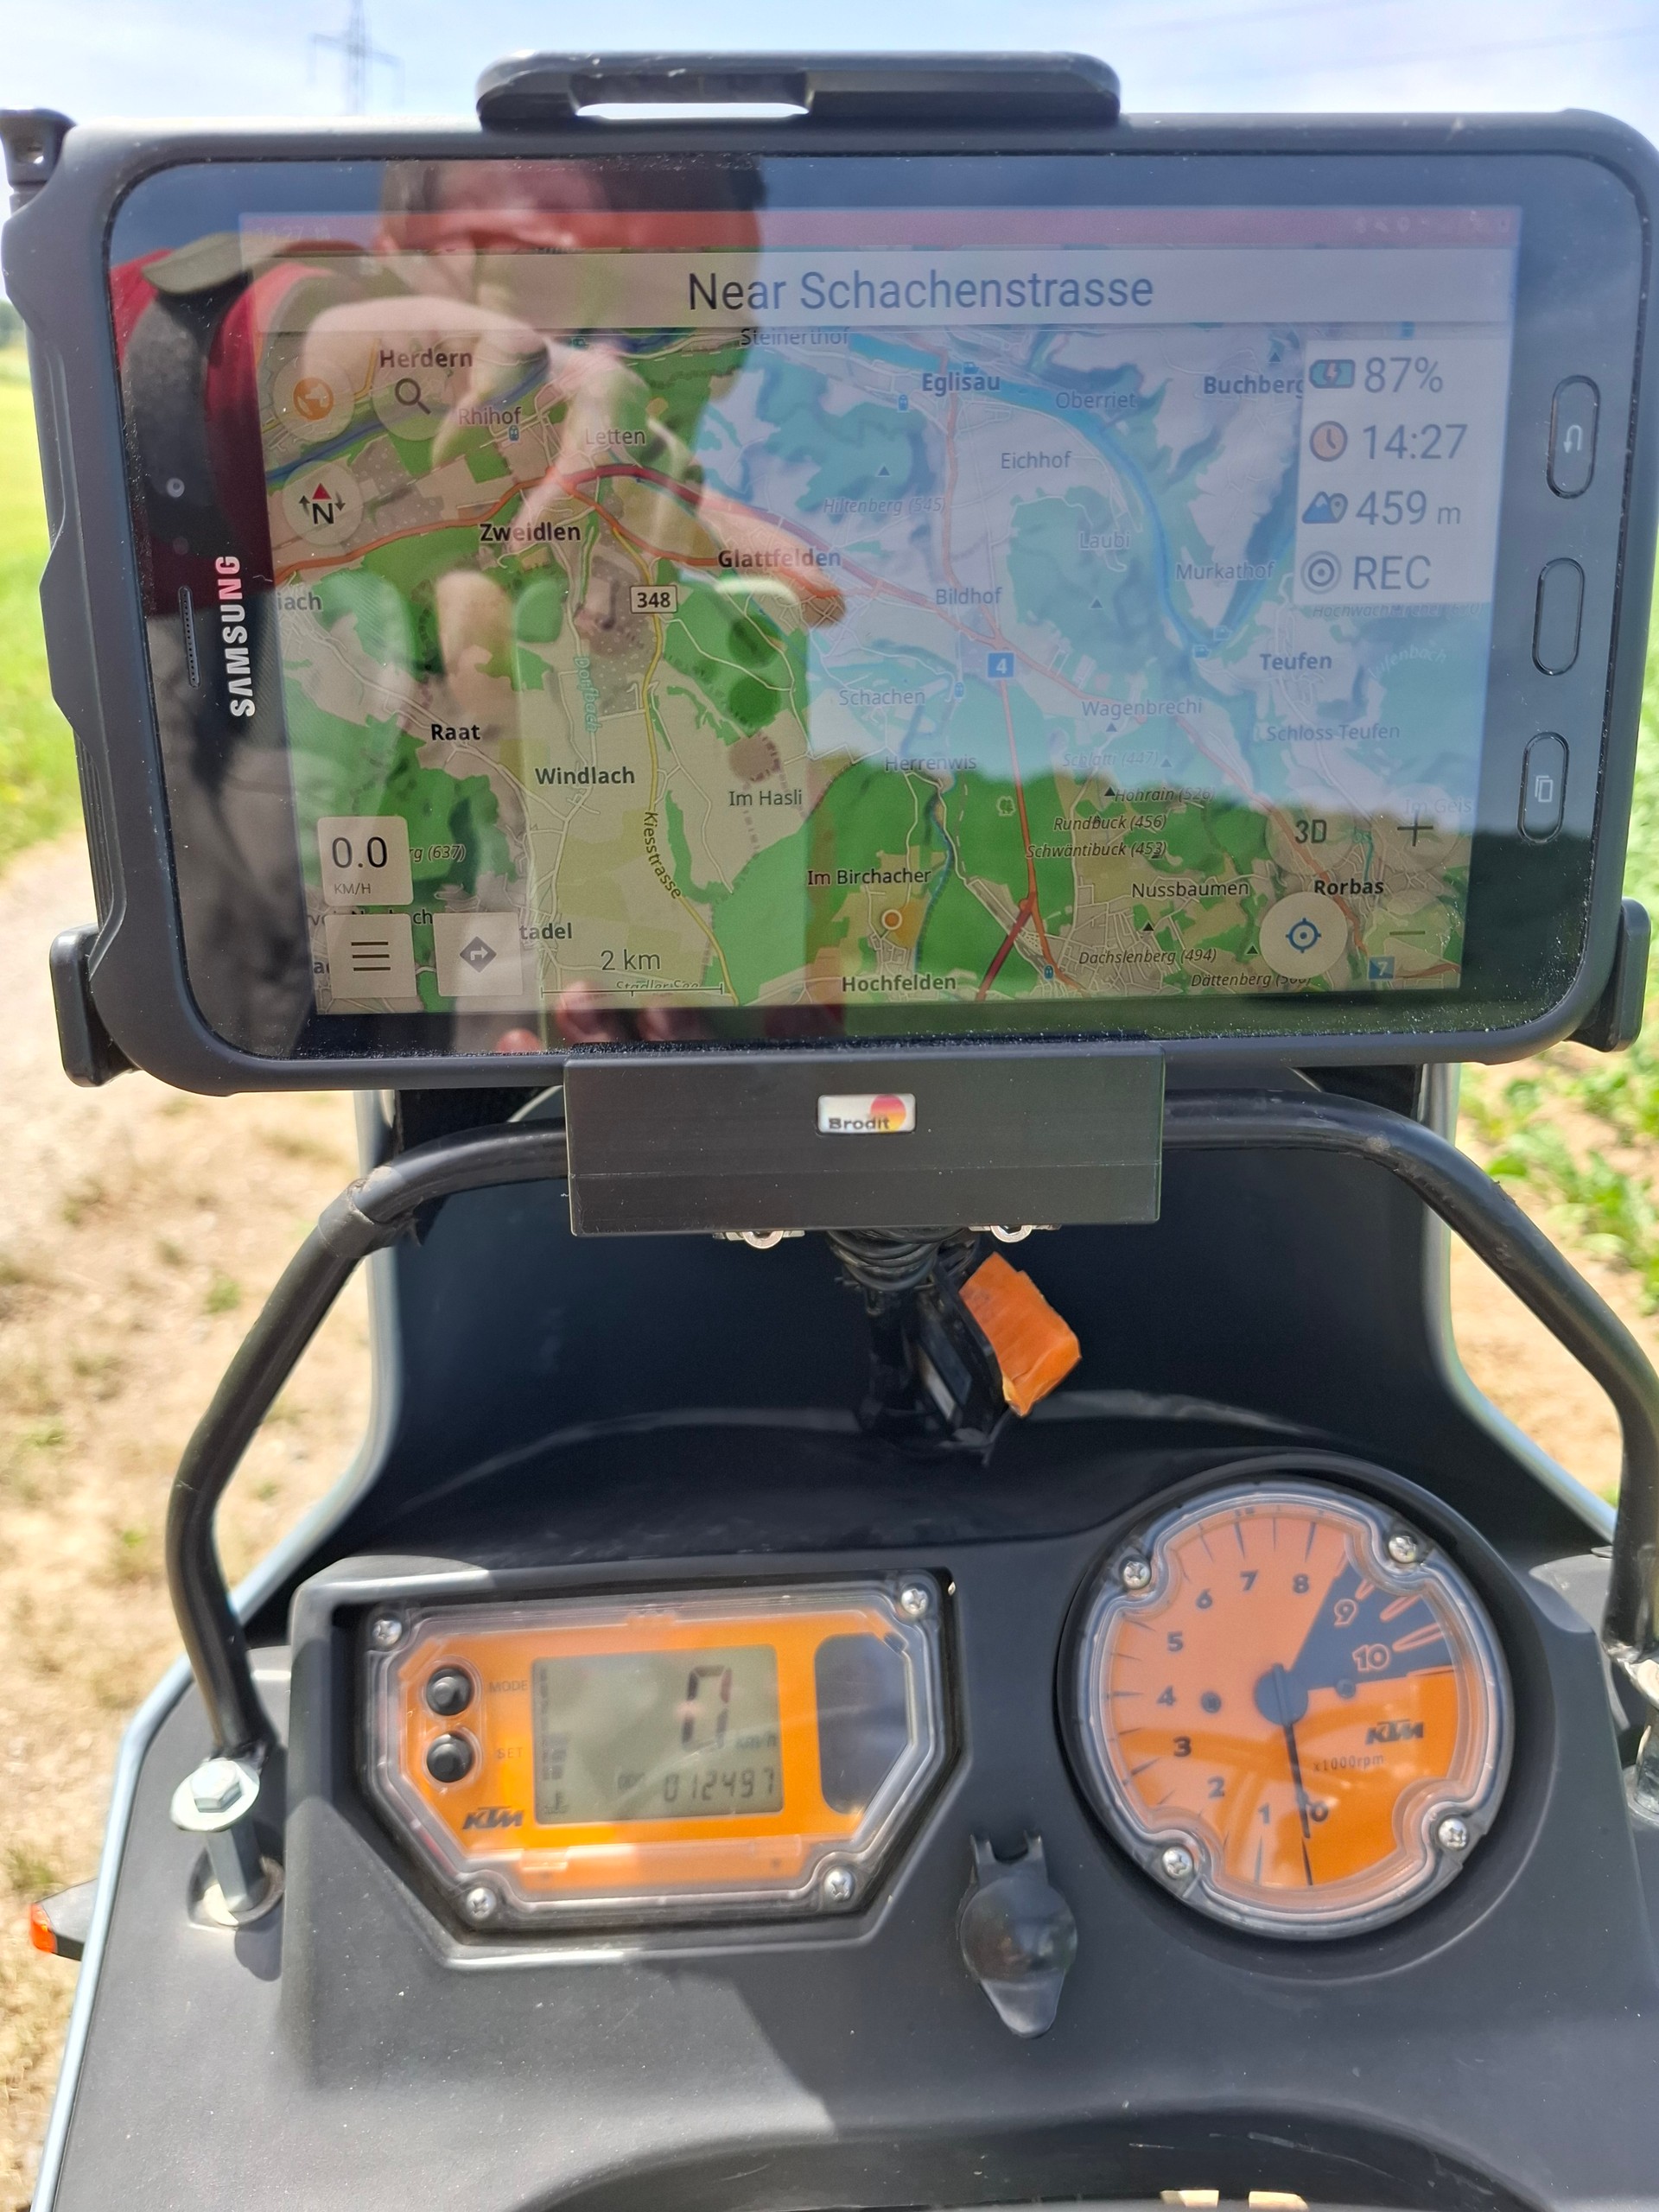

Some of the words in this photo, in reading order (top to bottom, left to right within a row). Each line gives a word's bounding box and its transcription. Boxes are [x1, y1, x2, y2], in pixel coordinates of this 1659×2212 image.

[690, 273, 786, 309] Near
[800, 270, 1154, 308] Schachenstrasse
[741, 327, 850, 346] Steinerthof
[378, 348, 474, 368] Herdern
[922, 372, 1001, 396] Eglisau
[1363, 357, 1444, 393] 87%
[1055, 391, 1136, 410] Oberriet
[458, 406, 522, 426] Rhihof
[585, 428, 646, 446] Letten
[1362, 423, 1468, 461] 14:27
[1001, 450, 1072, 470] Eichhof
[311, 502, 335, 525] N
[823, 496, 904, 517] Hiltenberg
[907, 496, 946, 515] (545)
[1355, 490, 1427, 525] 459
[1438, 505, 1461, 525] m
[480, 523, 582, 543] Zweidlen
[1079, 532, 1131, 550] Laubi
[717, 549, 842, 569] Glattfelden
[1176, 561, 1275, 580] Murkathof
[1352, 555, 1432, 590] REC
[636, 591, 671, 609] 348
[936, 587, 1003, 605] Bildhof
[215, 556, 256, 717] SAMSUNG
[995, 658, 1008, 674] 4
[1259, 652, 1333, 671] Teufen
[575, 656, 603, 734] Dorfbach
[838, 687, 926, 707] Schachen
[1081, 698, 1203, 719] Wagenbrechi
[430, 723, 481, 741] Raat
[1266, 724, 1333, 742] Schloss
[1338, 722, 1402, 741] Teufen
[884, 753, 977, 772] Herrenwis
[1121, 751, 1159, 768] (447)
[534, 766, 635, 785] Windlach
[728, 791, 753, 807] Im
[759, 789, 803, 807] Hasli
[1053, 815, 1127, 831] Rundbuck
[1129, 814, 1167, 831] (456)
[1294, 819, 1327, 844] 3D
[331, 836, 388, 868] 0.0
[428, 844, 467, 862] (637)
[643, 812, 682, 900] Kiesstrasse
[1025, 842, 1127, 860] Schwäntibuck
[1130, 841, 1166, 858] (453)
[808, 869, 831, 886] Im
[836, 868, 931, 886] Birchacher
[334, 883, 372, 895] KM/H
[1131, 880, 1249, 899] Nussbaumen
[1313, 879, 1384, 896] Rorbas
[600, 950, 616, 971] 2
[623, 949, 661, 970] km
[1077, 948, 1176, 966] Dachslenberg
[1179, 947, 1217, 965] (494)
[841, 975, 957, 994] Hochfelden
[1191, 971, 1272, 988] Dättenberg
[828, 1116, 891, 1130] Brodit
[1241, 1571, 1260, 1592] 7
[1292, 1573, 1310, 1594] 8
[1195, 1591, 1213, 1610] 6
[1333, 1599, 1358, 1626] 9
[1166, 1631, 1184, 1652] 5
[1352, 1643, 1391, 1672] 10
[489, 1680, 528, 1694] MODE
[1156, 1686, 1177, 1707] 4
[1365, 1719, 1424, 1744] KTM
[497, 1746, 524, 1759] SET
[1173, 1736, 1192, 1758] 3
[663, 1766, 775, 1802] 012497
[1207, 1777, 1226, 1799] 2
[462, 1805, 524, 1830] KTM
[1258, 1802, 1271, 1824] 1
[1309, 1801, 1330, 1823] 0
